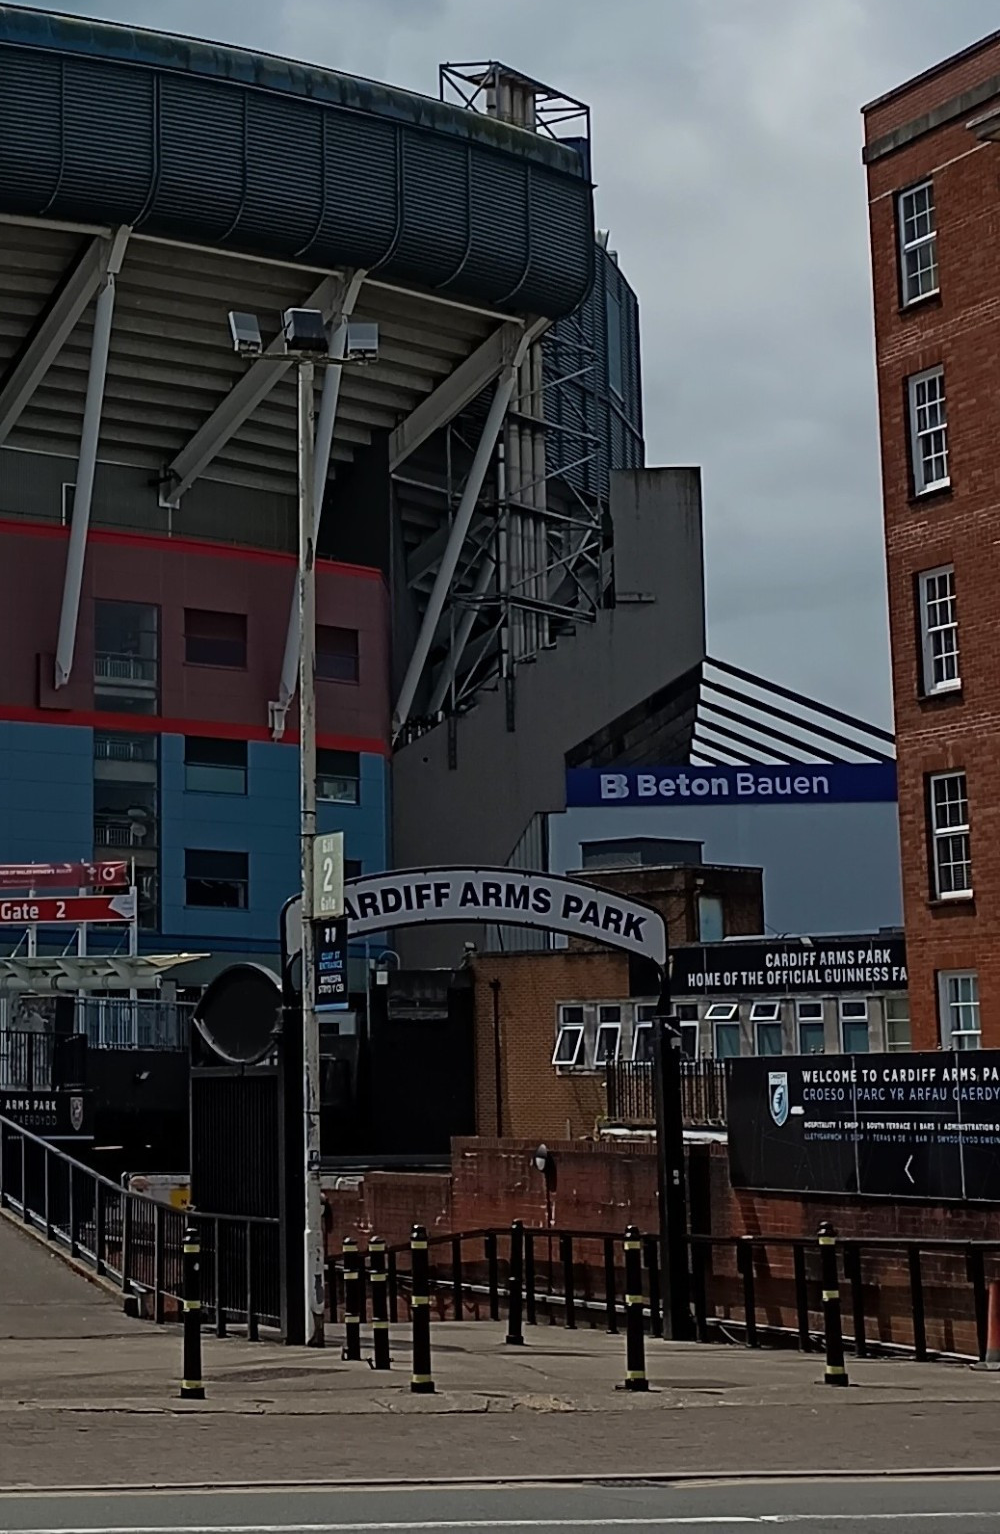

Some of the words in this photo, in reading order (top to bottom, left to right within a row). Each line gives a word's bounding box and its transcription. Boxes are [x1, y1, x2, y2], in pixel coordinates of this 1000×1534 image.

[637, 773, 729, 797] Beton
[737, 772, 830, 796] Bauen
[323, 857, 333, 892] 2
[1, 903, 39, 920] Gate
[56, 901, 66, 918] 2
[343, 882, 451, 921] ARDIFF
[460, 881, 552, 913] ARMS
[561, 894, 646, 942] PARK
[765, 951, 816, 967] CARDIFF
[820, 949, 855, 966] ARMS
[858, 948, 892, 964] PARK
[687, 971, 720, 987] HOME
[723, 971, 739, 986] OF
[740, 970, 763, 985] THE
[766, 969, 822, 985] OFFICIAL
[824, 967, 889, 983] GUINNESS
[892, 966, 908, 981] FA
[802, 1069, 857, 1083] WELCOME
[862, 1069, 878, 1082] TO
[882, 1068, 937, 1082] CARDIFF
[942, 1067, 977, 1082] ARMS
[982, 1066, 1000, 1082] PA
[802, 1087, 844, 1101] CROESO
[857, 1087, 886, 1101] PARC
[890, 1087, 905, 1101] YR
[909, 1087, 947, 1101] ARFAU
[952, 1087, 1000, 1101] CAERDY
[5, 1099, 30, 1111] ARMS
[33, 1099, 57, 1111] PARK
